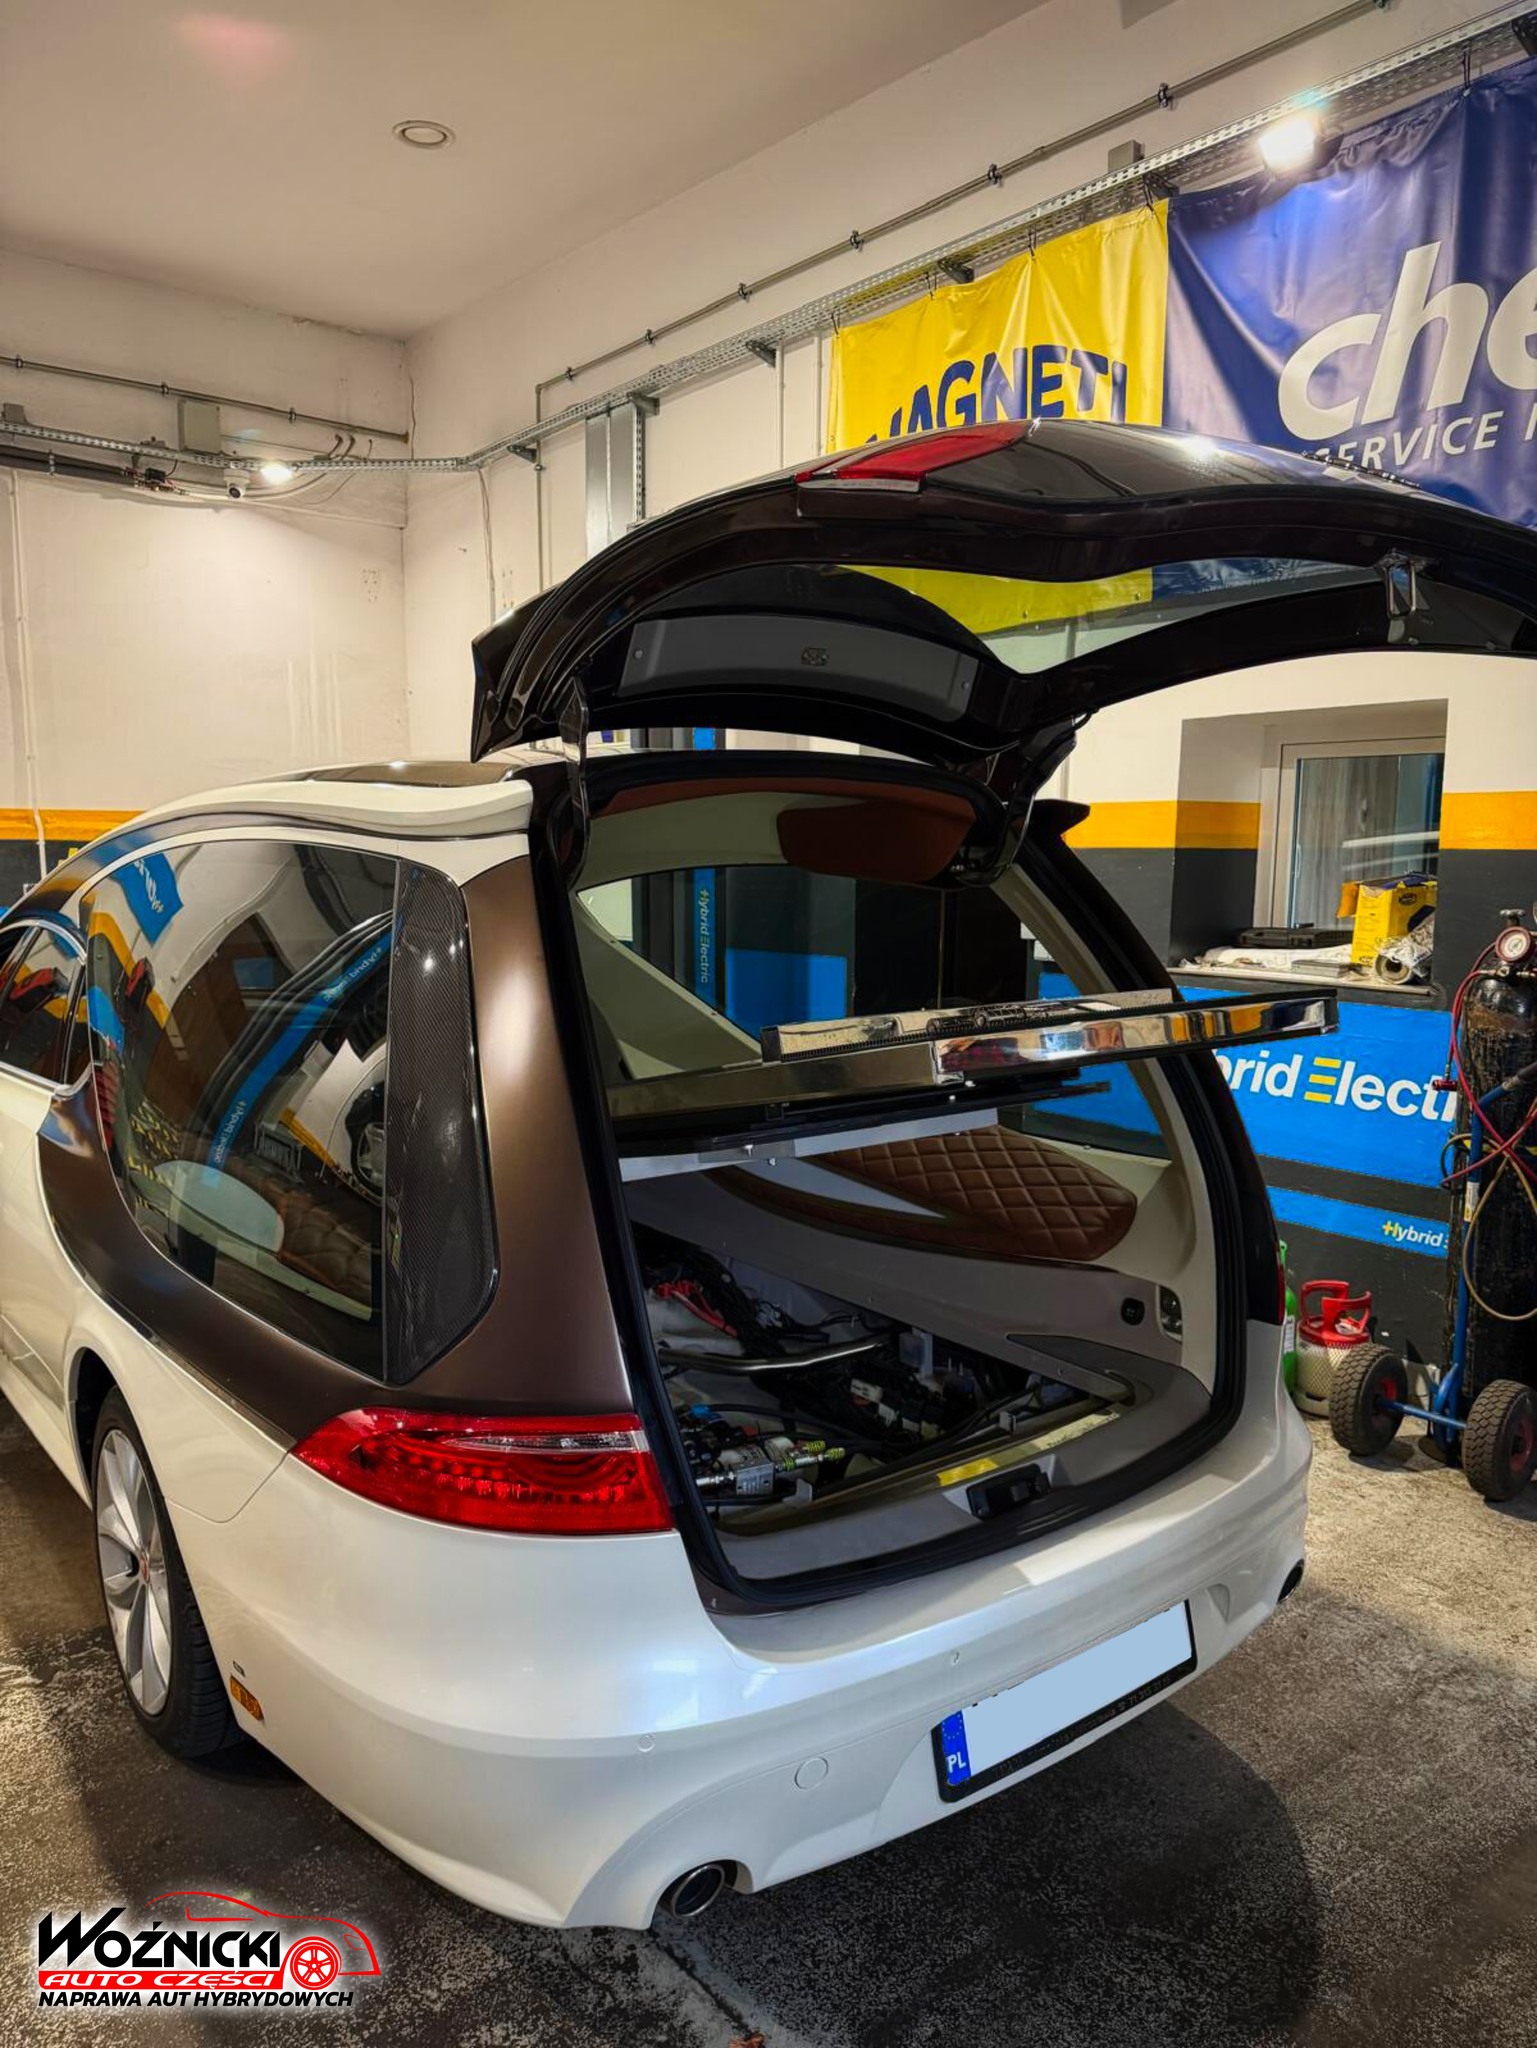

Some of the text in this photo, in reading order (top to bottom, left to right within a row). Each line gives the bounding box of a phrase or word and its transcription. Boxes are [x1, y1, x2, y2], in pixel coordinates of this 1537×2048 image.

[866, 344, 1127, 443] AGNETI
[1382, 1220, 1448, 1249] Hybrid
[946, 1751, 967, 1773] PL
